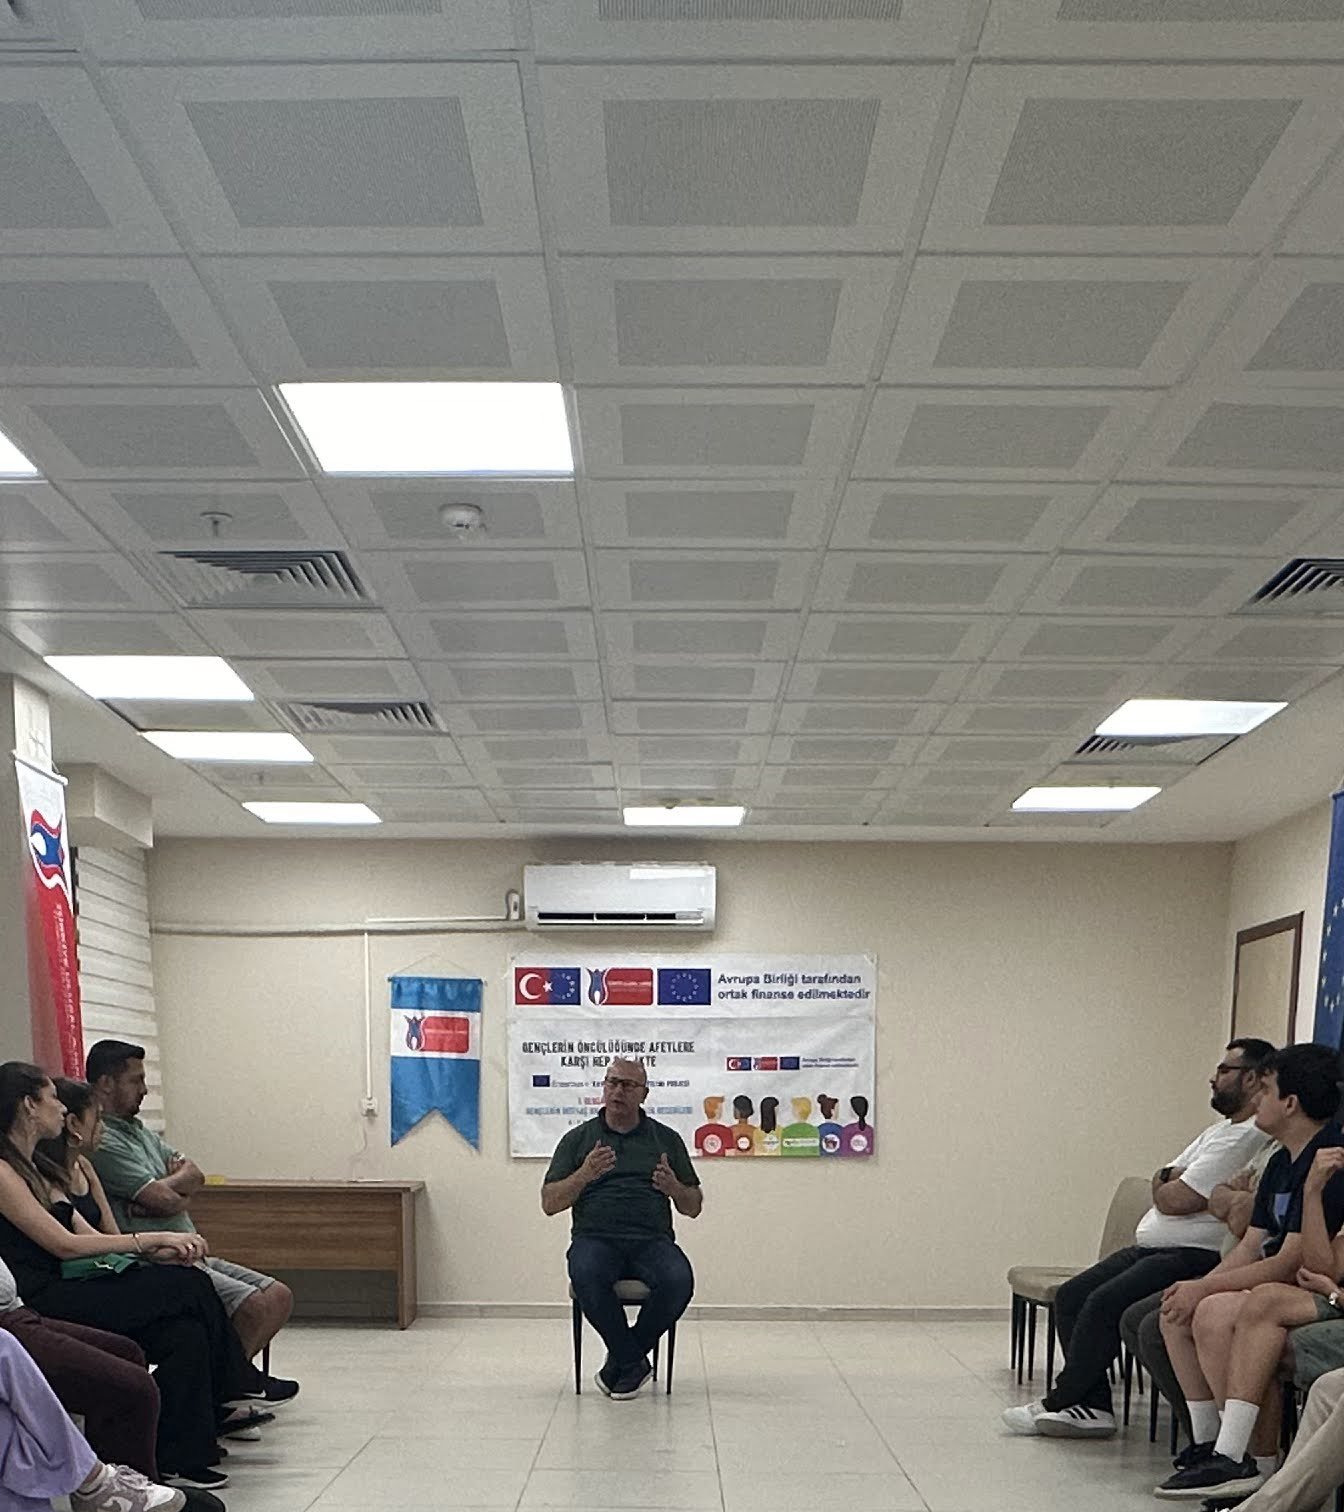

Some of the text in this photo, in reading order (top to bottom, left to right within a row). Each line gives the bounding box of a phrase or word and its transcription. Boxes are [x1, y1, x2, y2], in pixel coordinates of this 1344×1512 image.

[717, 973, 862, 987] Avrupa Birliği tarafından
[717, 988, 871, 1000] ortak finanse edilmektedir
[648, 1041, 695, 1053] AFETLERE
